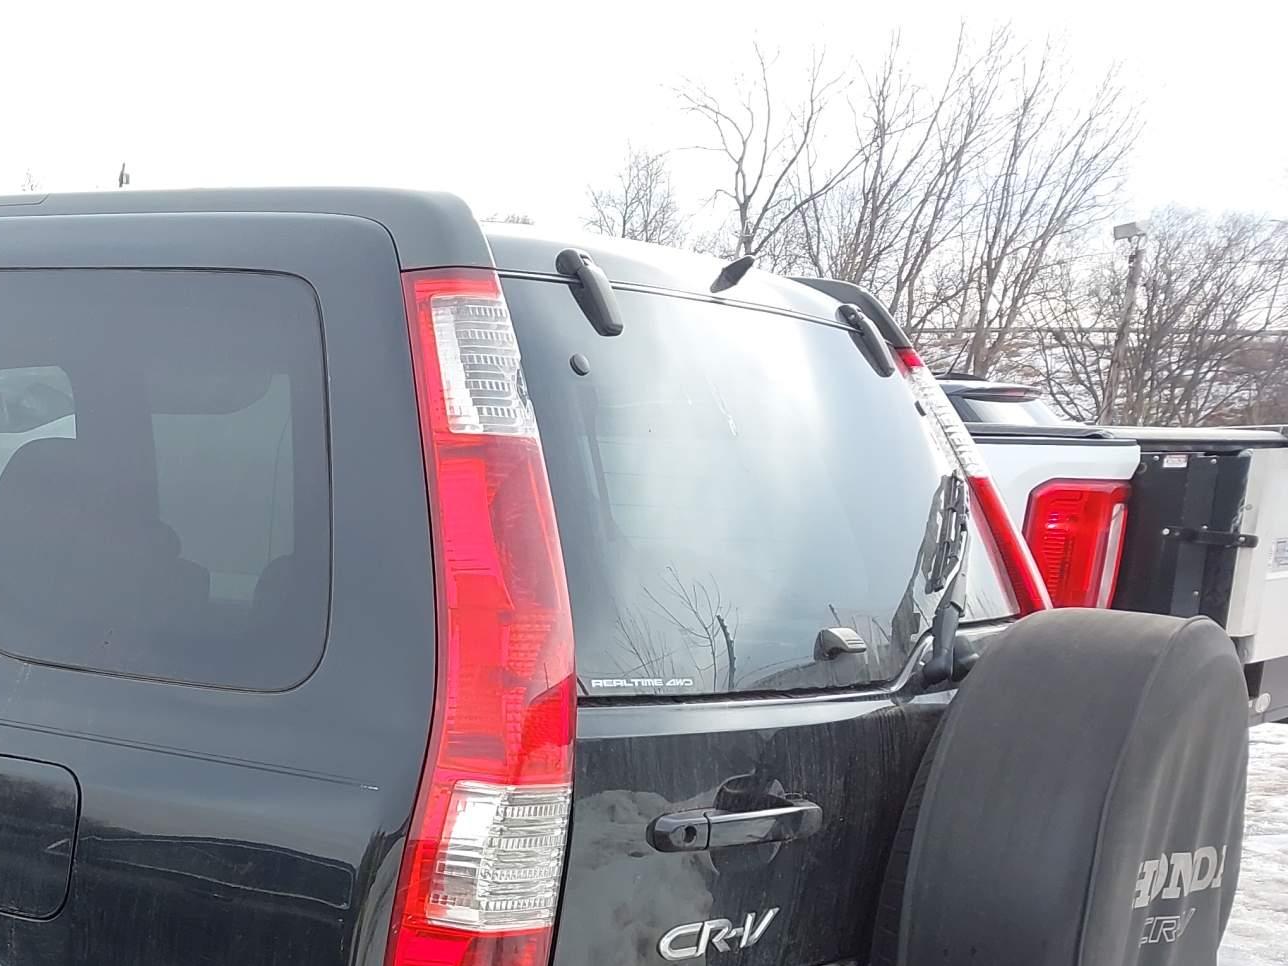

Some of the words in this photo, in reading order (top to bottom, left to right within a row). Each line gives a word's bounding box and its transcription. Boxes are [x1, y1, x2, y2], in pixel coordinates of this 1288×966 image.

[591, 678, 664, 688] REALTIME
[665, 678, 694, 687] 4WD
[658, 906, 780, 961] CR-V
